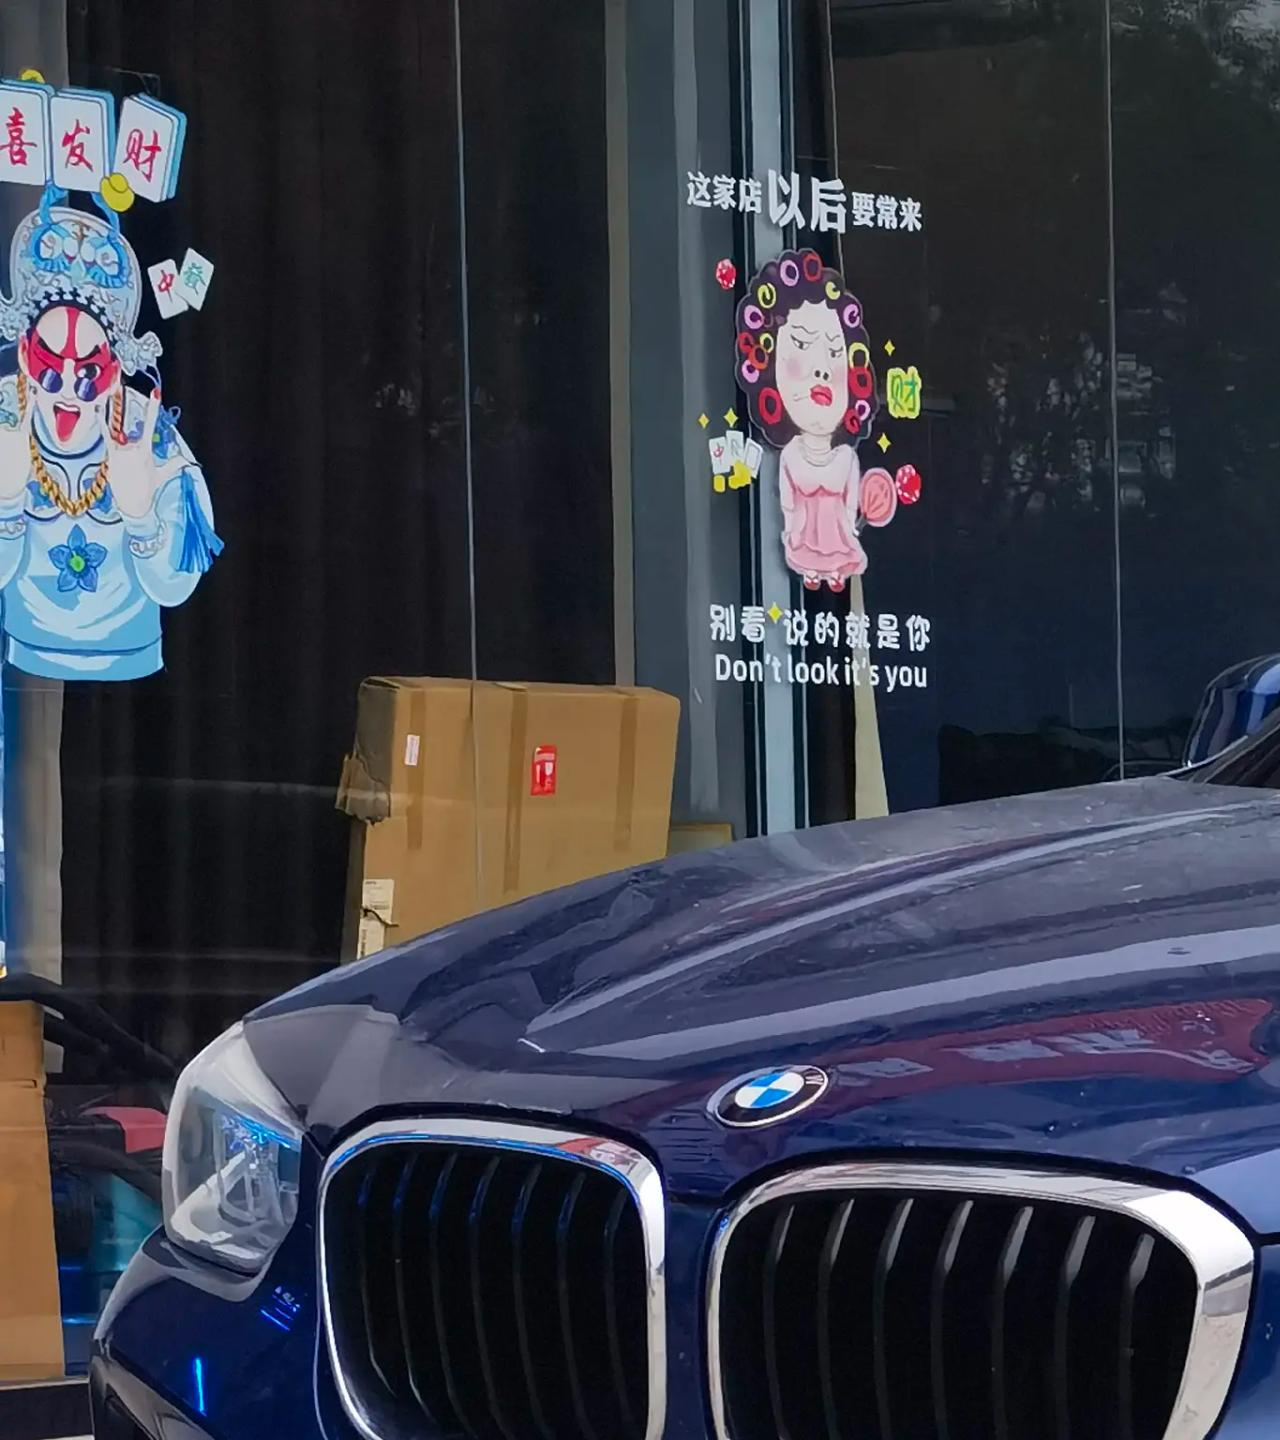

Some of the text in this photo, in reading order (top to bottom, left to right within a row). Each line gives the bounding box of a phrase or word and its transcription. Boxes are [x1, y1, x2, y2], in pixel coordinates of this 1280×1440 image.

[715, 653, 928, 693] Don't look it's you
